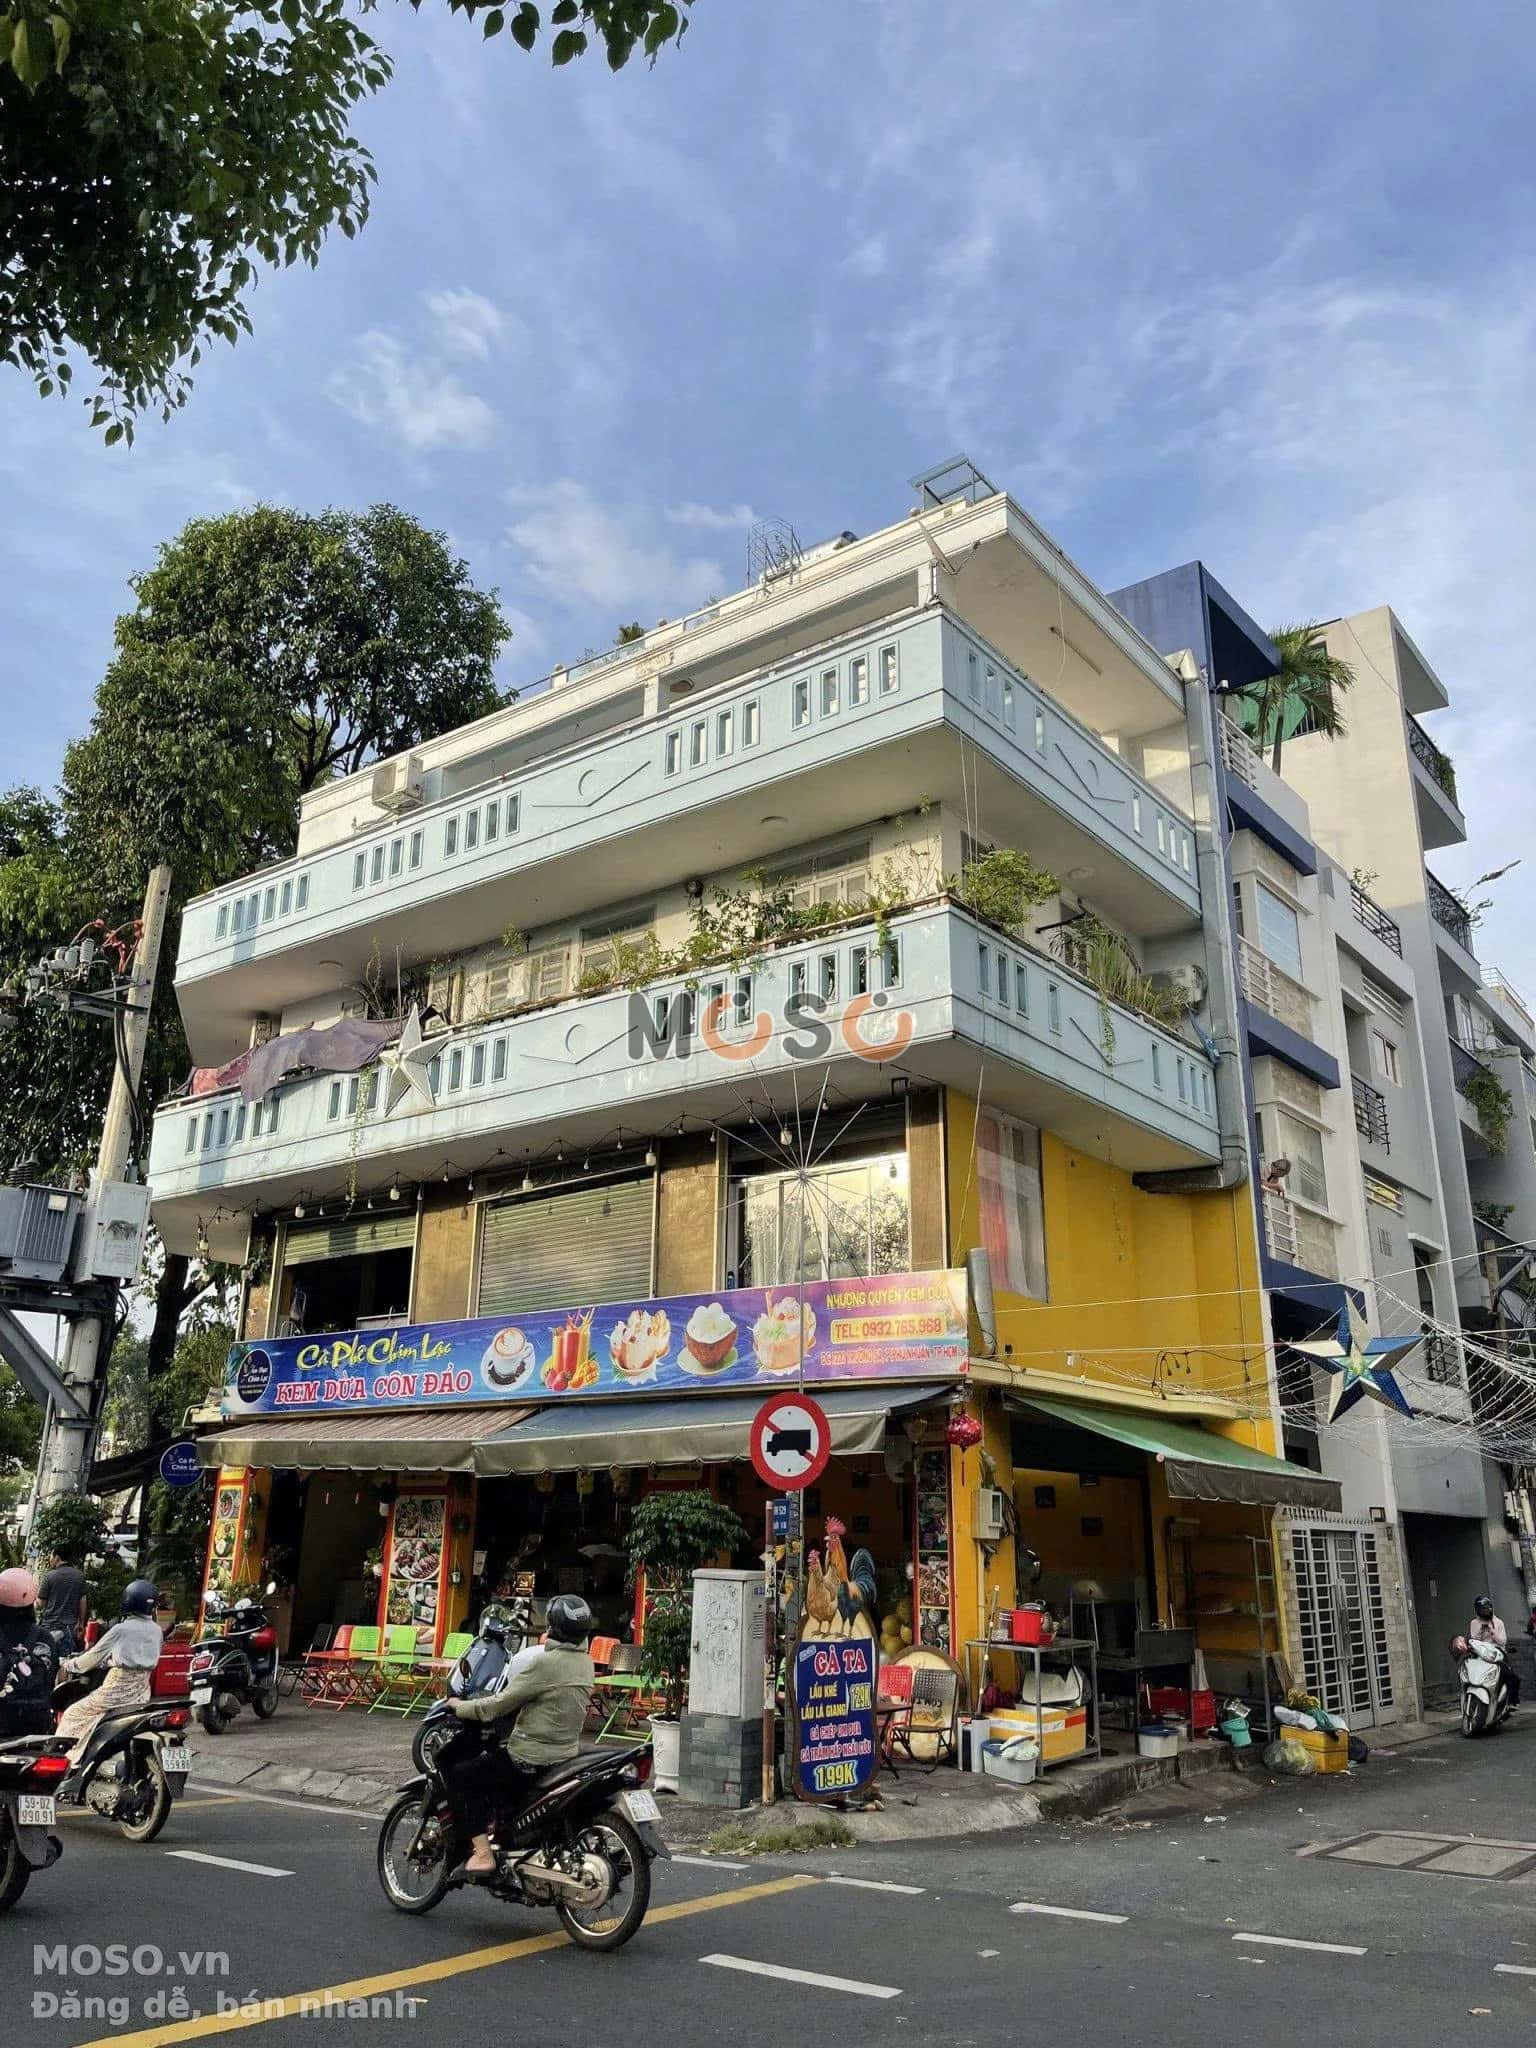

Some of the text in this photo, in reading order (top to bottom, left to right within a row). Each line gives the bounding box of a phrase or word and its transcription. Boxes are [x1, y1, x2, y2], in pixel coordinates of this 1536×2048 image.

[904, 1287, 925, 1302] KEM
[296, 1343, 331, 1371] Cà
[331, 1334, 366, 1369] Phê
[275, 1362, 473, 1405] KEM DỪA CÔN ĐẢO
[843, 1648, 868, 1674] TA
[814, 1761, 857, 1790] 199K
